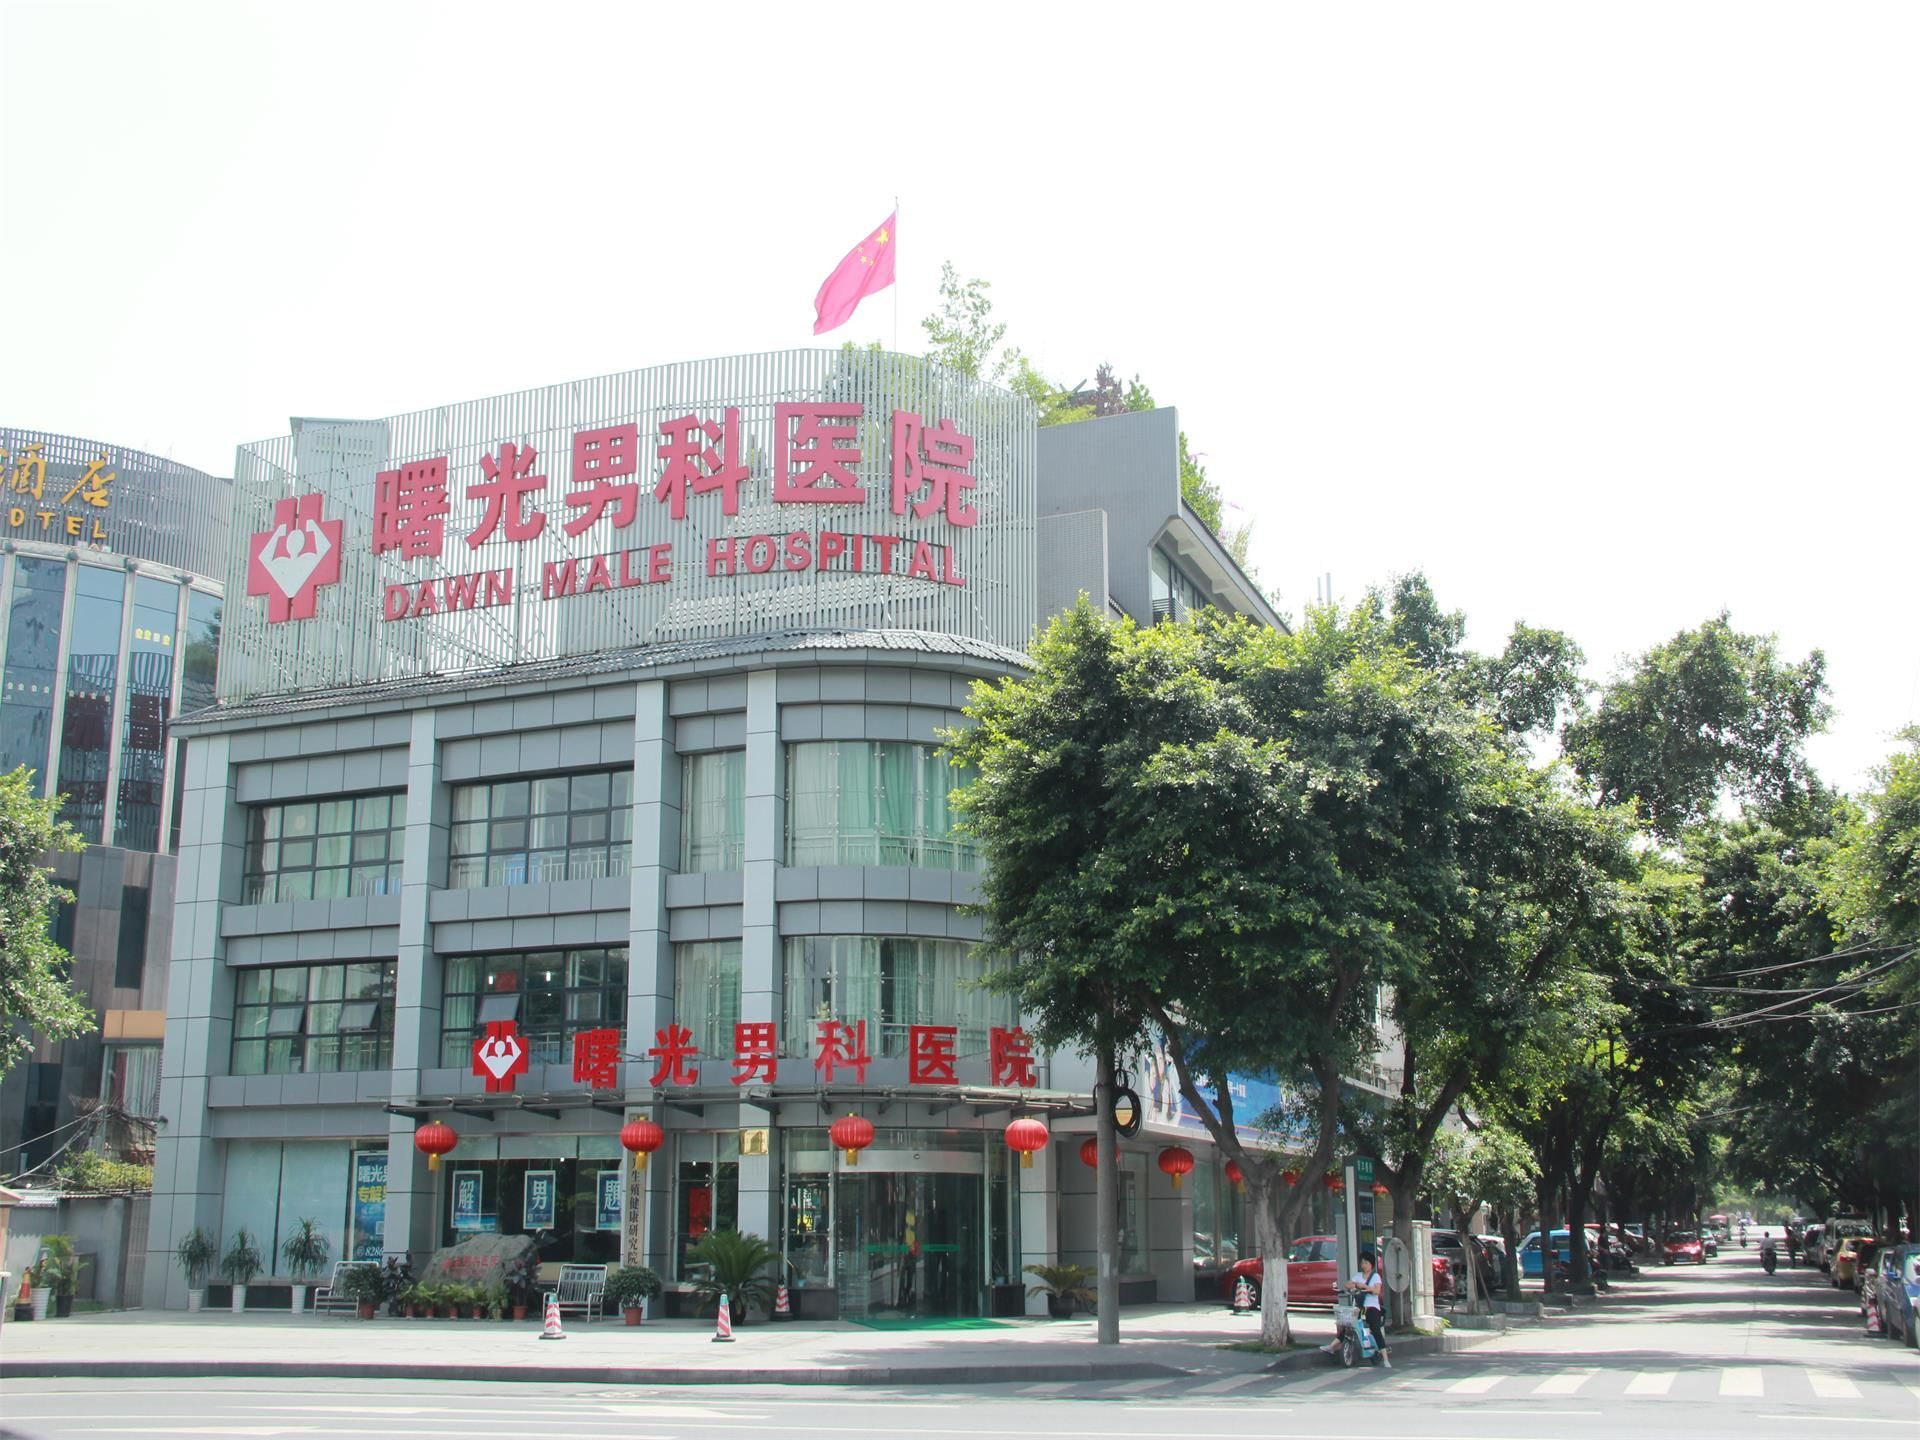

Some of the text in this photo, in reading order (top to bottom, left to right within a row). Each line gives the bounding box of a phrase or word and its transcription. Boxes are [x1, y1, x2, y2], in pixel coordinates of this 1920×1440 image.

[0, 443, 116, 508] 酒店
[372, 402, 978, 562] 曙光男科医院
[384, 530, 966, 622] DAWN MALE HOSPITAL
[572, 1019, 1038, 1089] 曙光男科医院
[532, 1179, 547, 1211] 男
